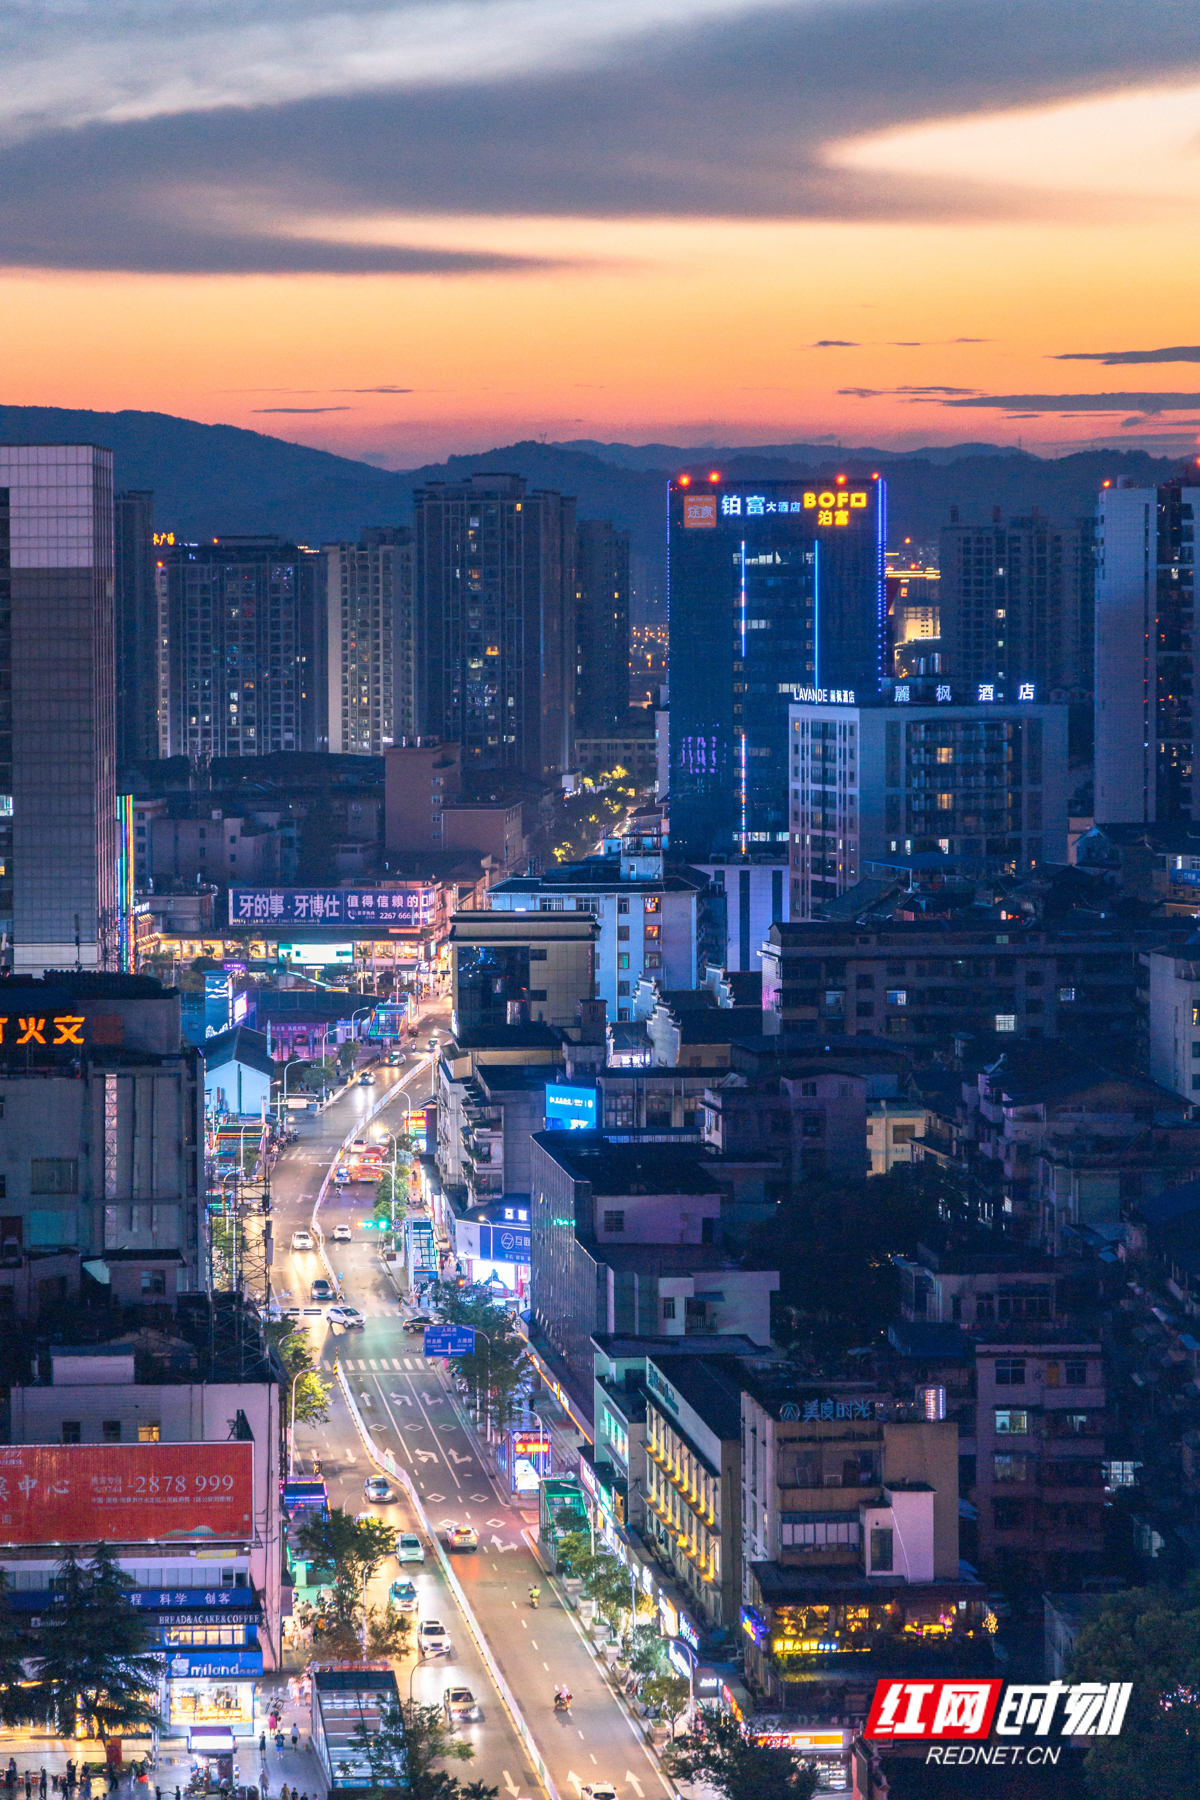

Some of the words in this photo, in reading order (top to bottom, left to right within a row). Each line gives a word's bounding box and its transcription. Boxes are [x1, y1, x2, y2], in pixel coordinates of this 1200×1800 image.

[721, 494, 801, 516] 铂富大酒店
[817, 510, 849, 526] 泊富
[793, 687, 828, 702] LAVANDE
[195, 1475, 234, 1493] 999
[159, 1593, 188, 1606] 科学
[204, 1592, 231, 1605] 创客
